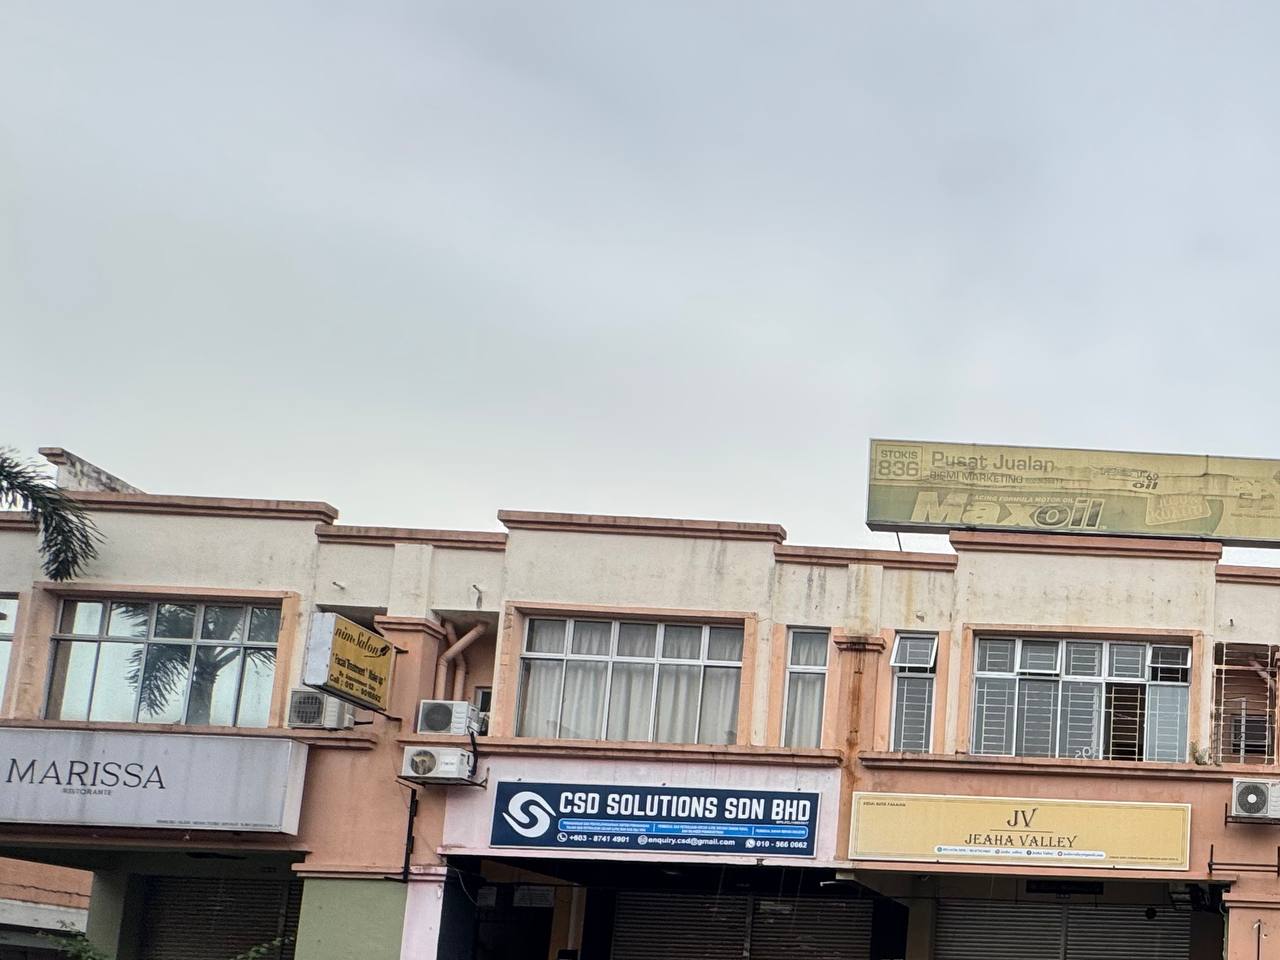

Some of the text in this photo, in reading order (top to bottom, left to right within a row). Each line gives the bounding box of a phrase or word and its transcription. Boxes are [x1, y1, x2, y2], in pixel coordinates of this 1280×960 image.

[881, 450, 918, 459] STOKIS
[931, 451, 1055, 473] Pusat Jualan
[879, 460, 919, 477] 836
[961, 471, 1023, 484] MARKETING
[910, 491, 1105, 529] Maxoil
[5, 758, 166, 789] MARISSA
[559, 791, 811, 821] CSD SOLUTIONS SDN BHD
[1007, 808, 1039, 828] JV
[965, 833, 1078, 849] JEAHA VALLEY
